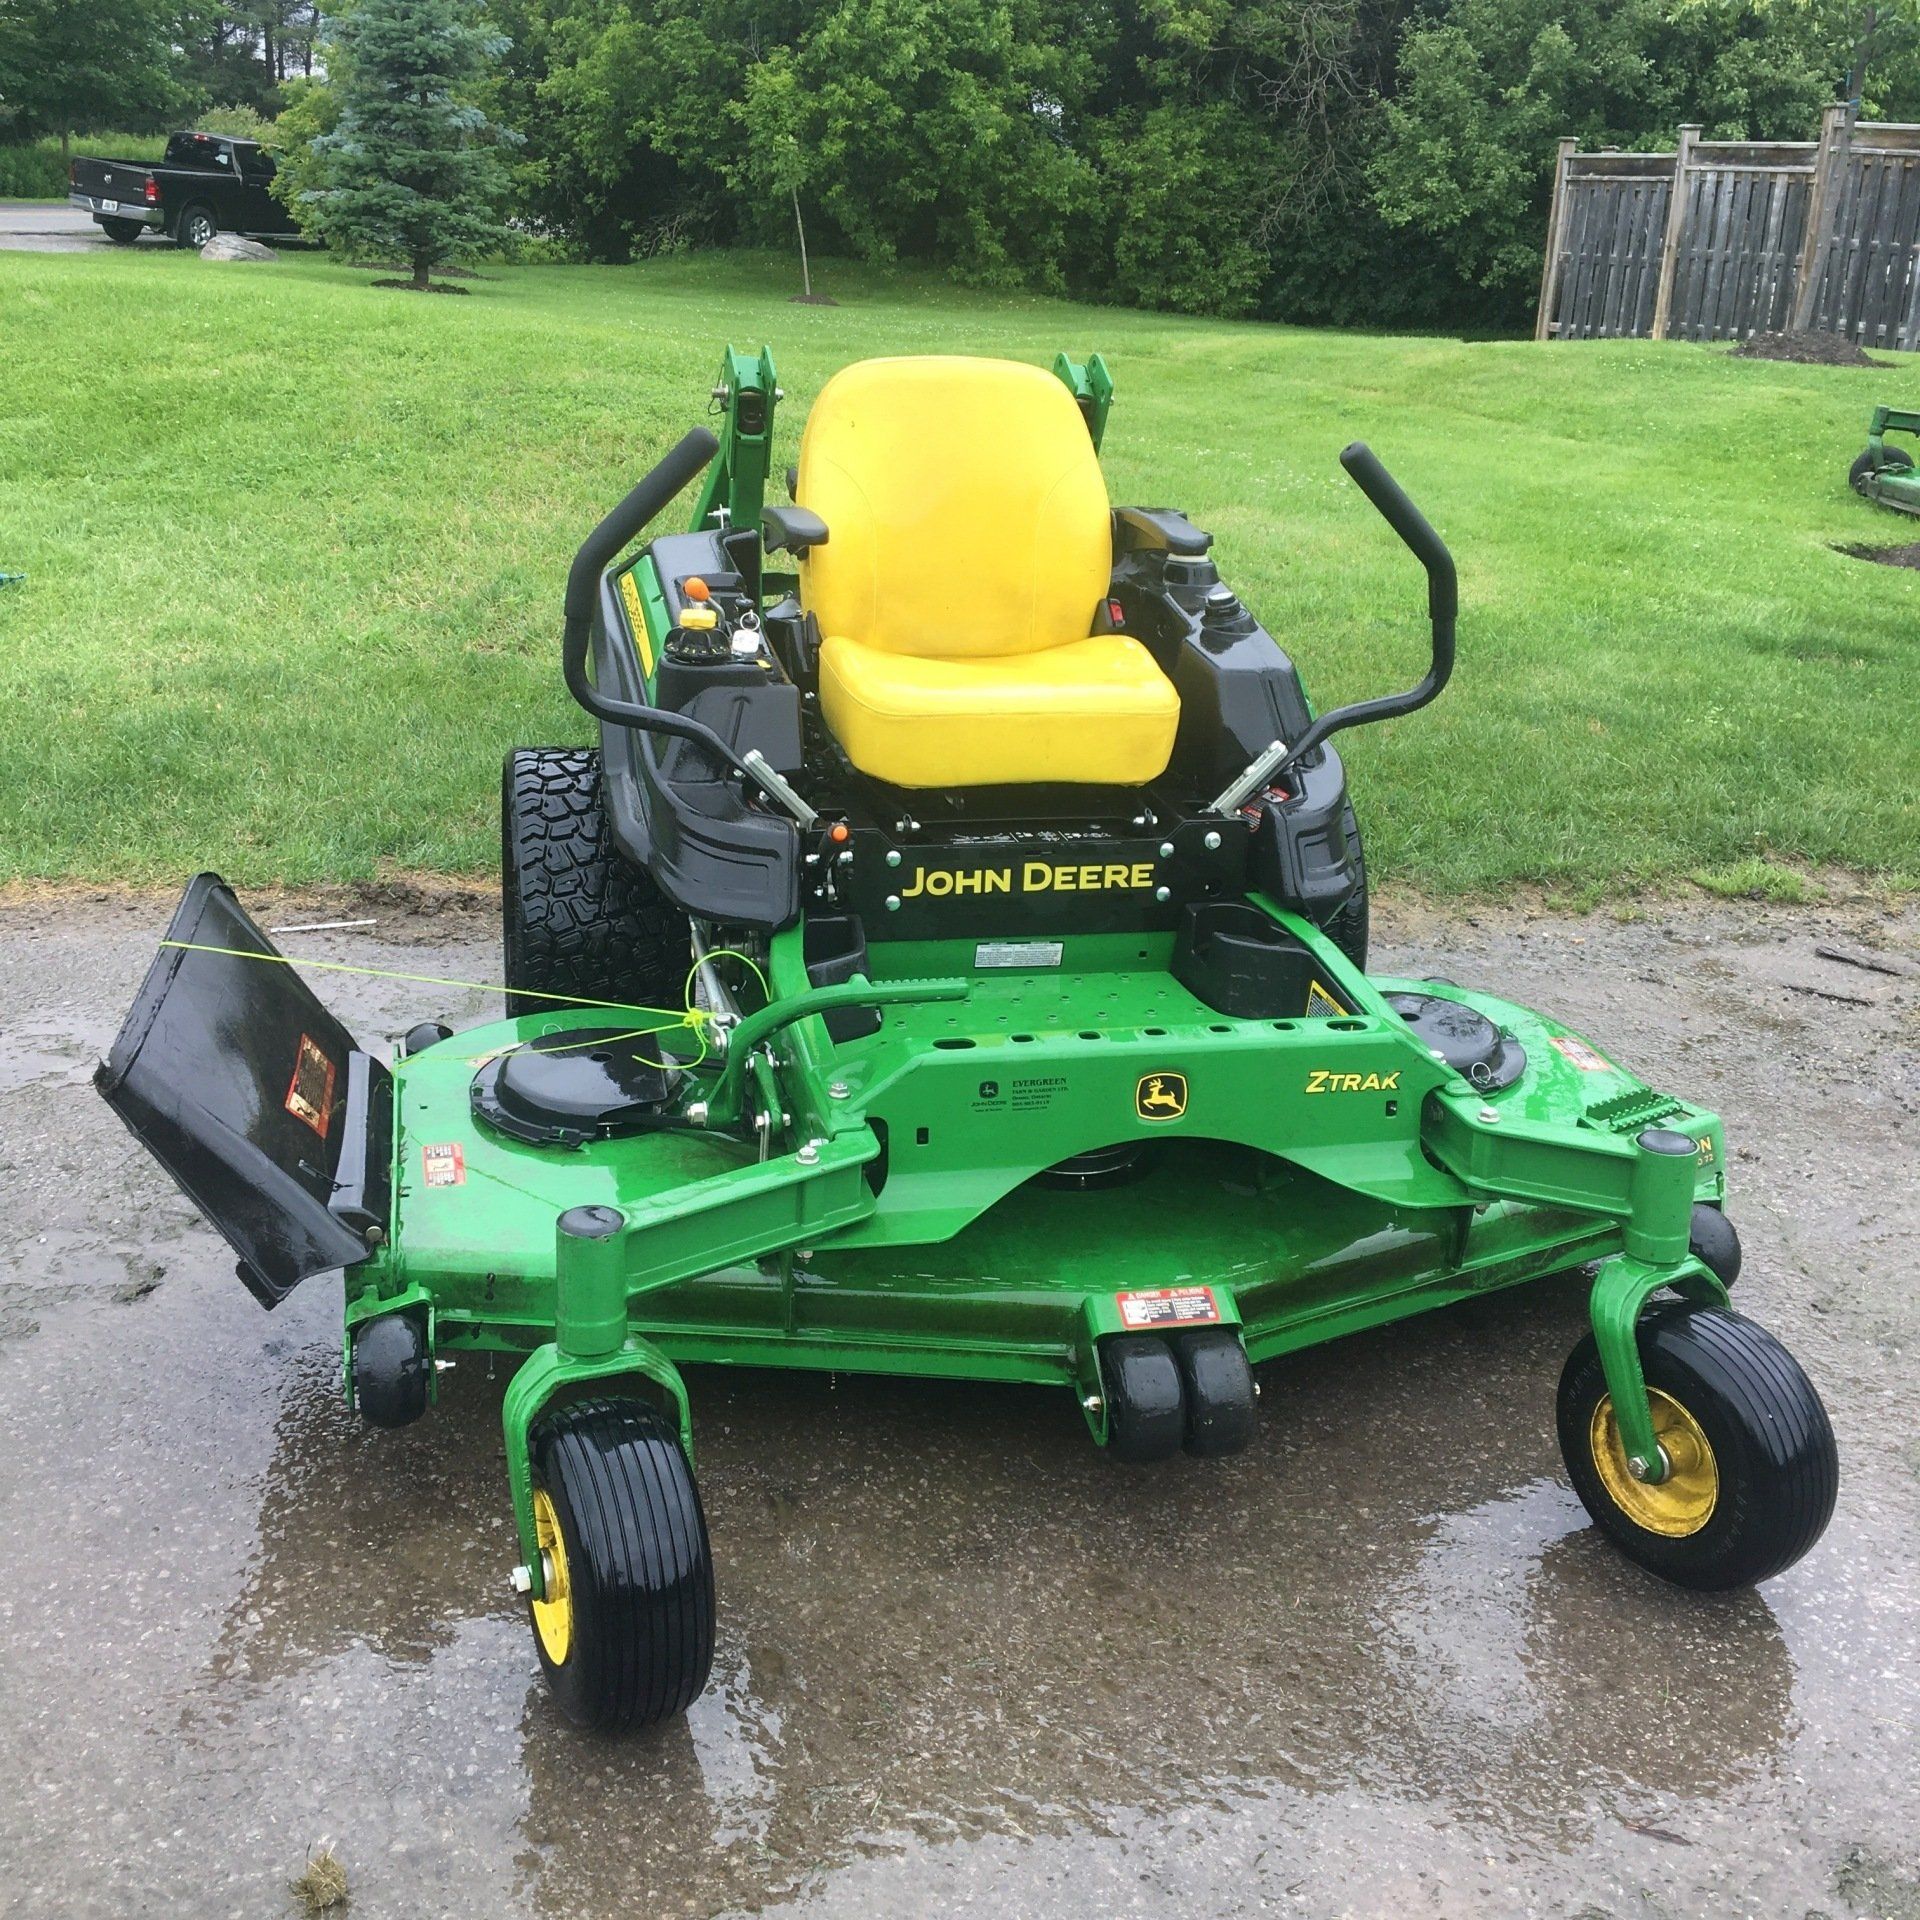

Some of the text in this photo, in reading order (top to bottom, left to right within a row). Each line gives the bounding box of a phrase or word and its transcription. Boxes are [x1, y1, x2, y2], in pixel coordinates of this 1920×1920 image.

[902, 862, 1155, 897] JOHN DEERE
[1012, 1078, 1067, 1088] EVERGREEN
[1305, 1070, 1401, 1093] ZTRAK
